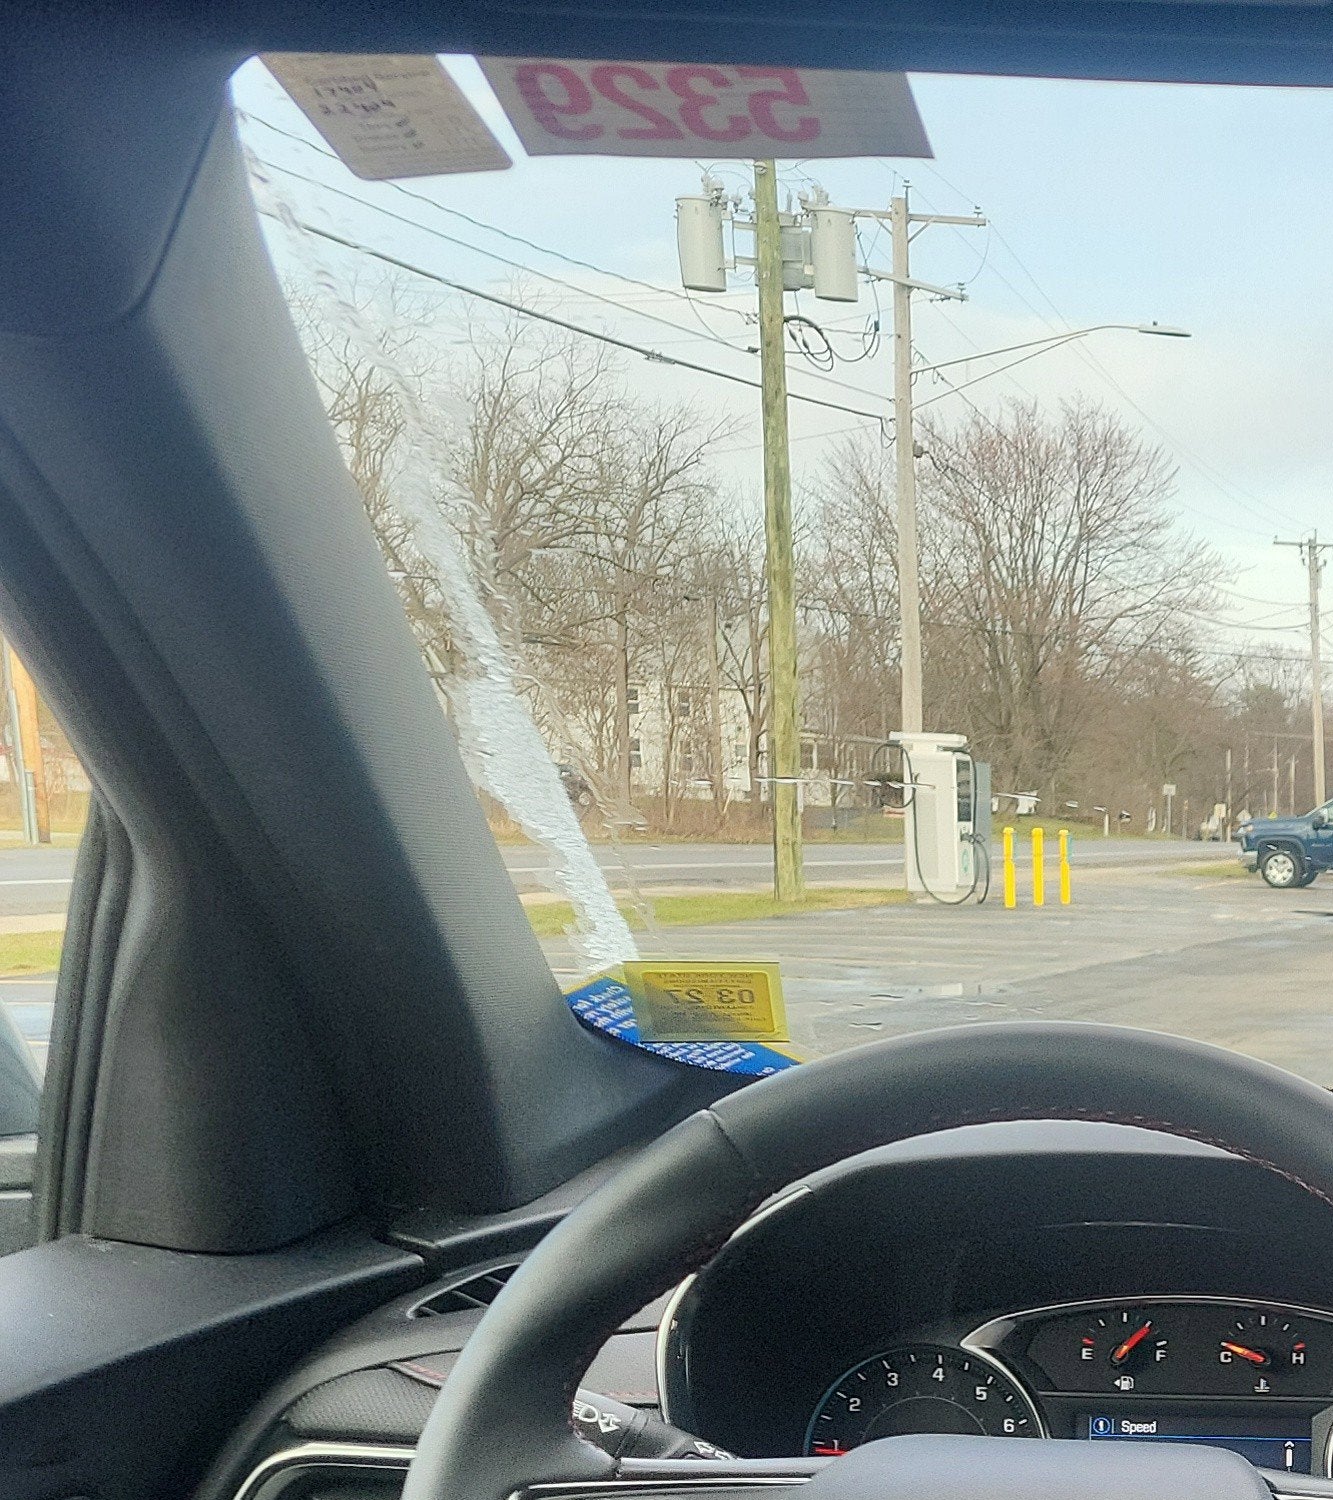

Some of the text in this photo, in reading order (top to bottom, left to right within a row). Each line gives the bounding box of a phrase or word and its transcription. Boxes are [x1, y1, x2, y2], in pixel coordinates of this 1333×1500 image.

[1082, 1347, 1093, 1360] E
[1156, 1349, 1166, 1362] F
[1220, 1351, 1232, 1363] C
[1292, 1352, 1305, 1365] H
[887, 1373, 899, 1386] 3
[932, 1367, 945, 1381] 4
[975, 1386, 987, 1401] 5
[849, 1397, 861, 1411] 2
[1003, 1418, 1014, 1433] 6
[1121, 1420, 1157, 1436] Speed
